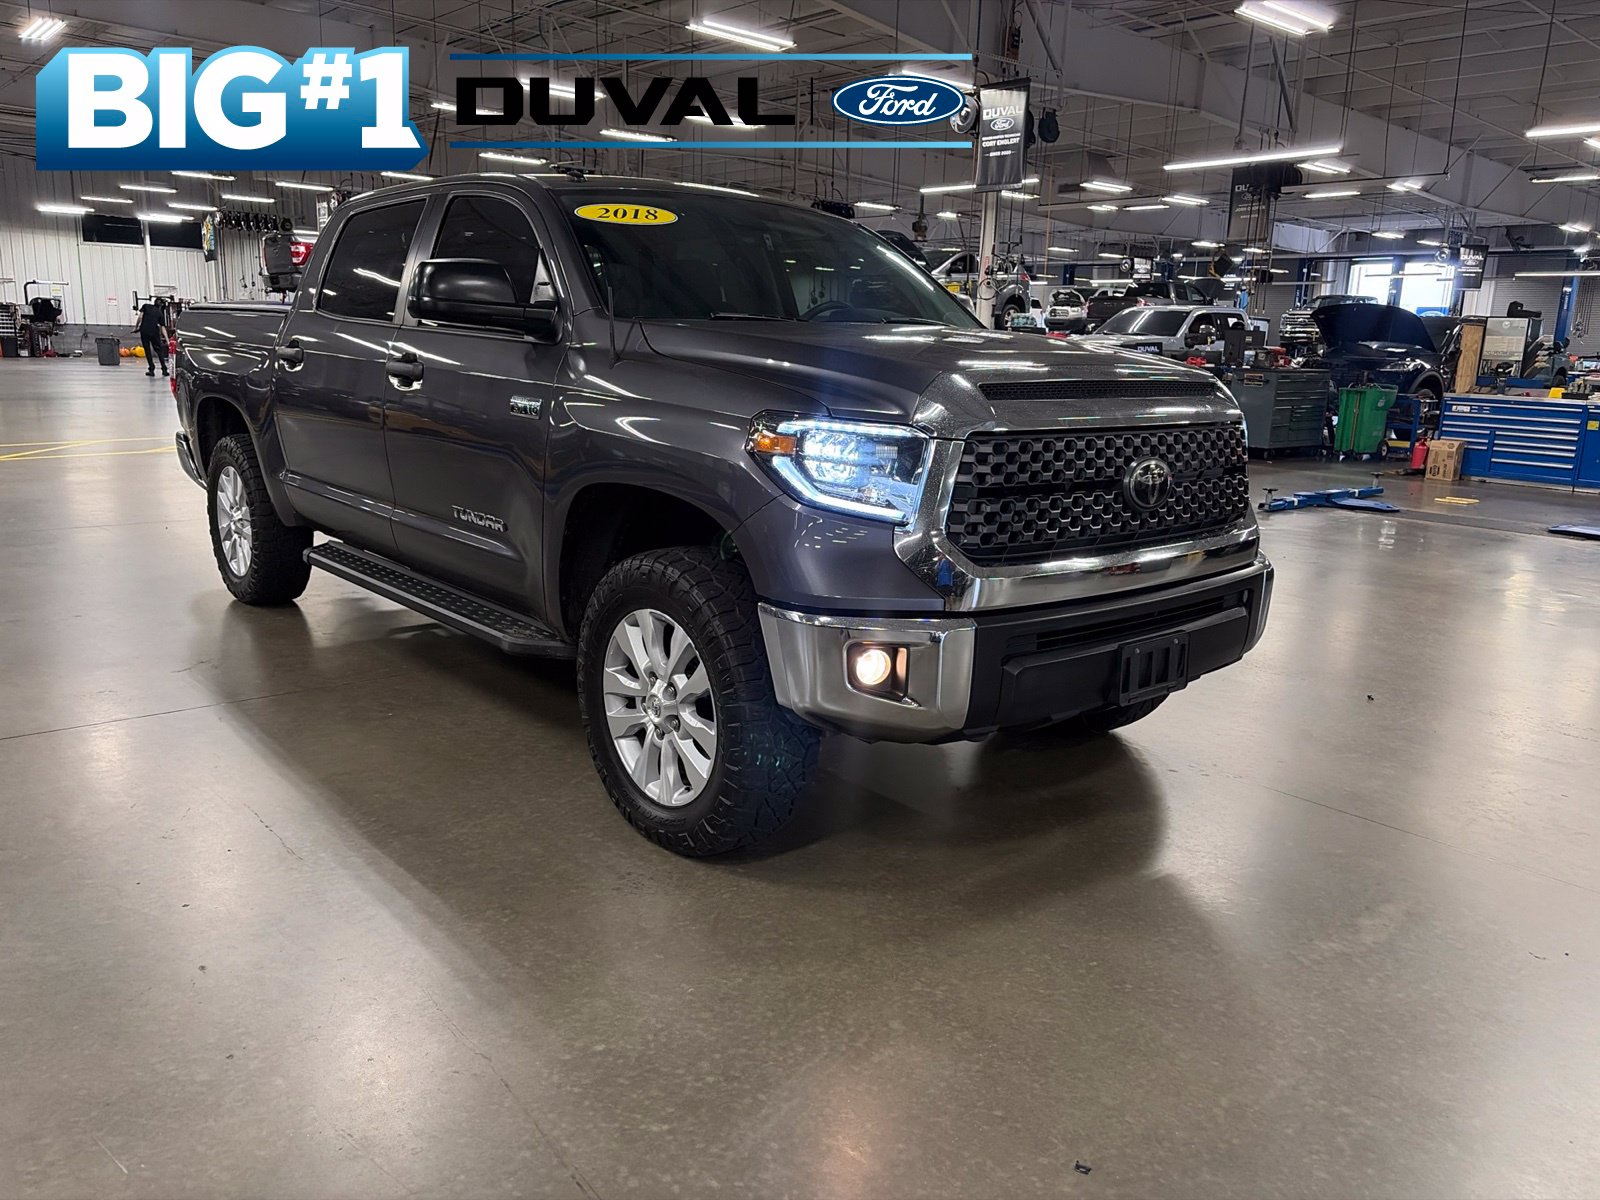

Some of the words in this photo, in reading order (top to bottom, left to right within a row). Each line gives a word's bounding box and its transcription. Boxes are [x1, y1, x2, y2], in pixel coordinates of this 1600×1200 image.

[982, 106, 1024, 121] DUVAL
[597, 207, 659, 221] 2018
[1137, 345, 1160, 353] DUVAL
